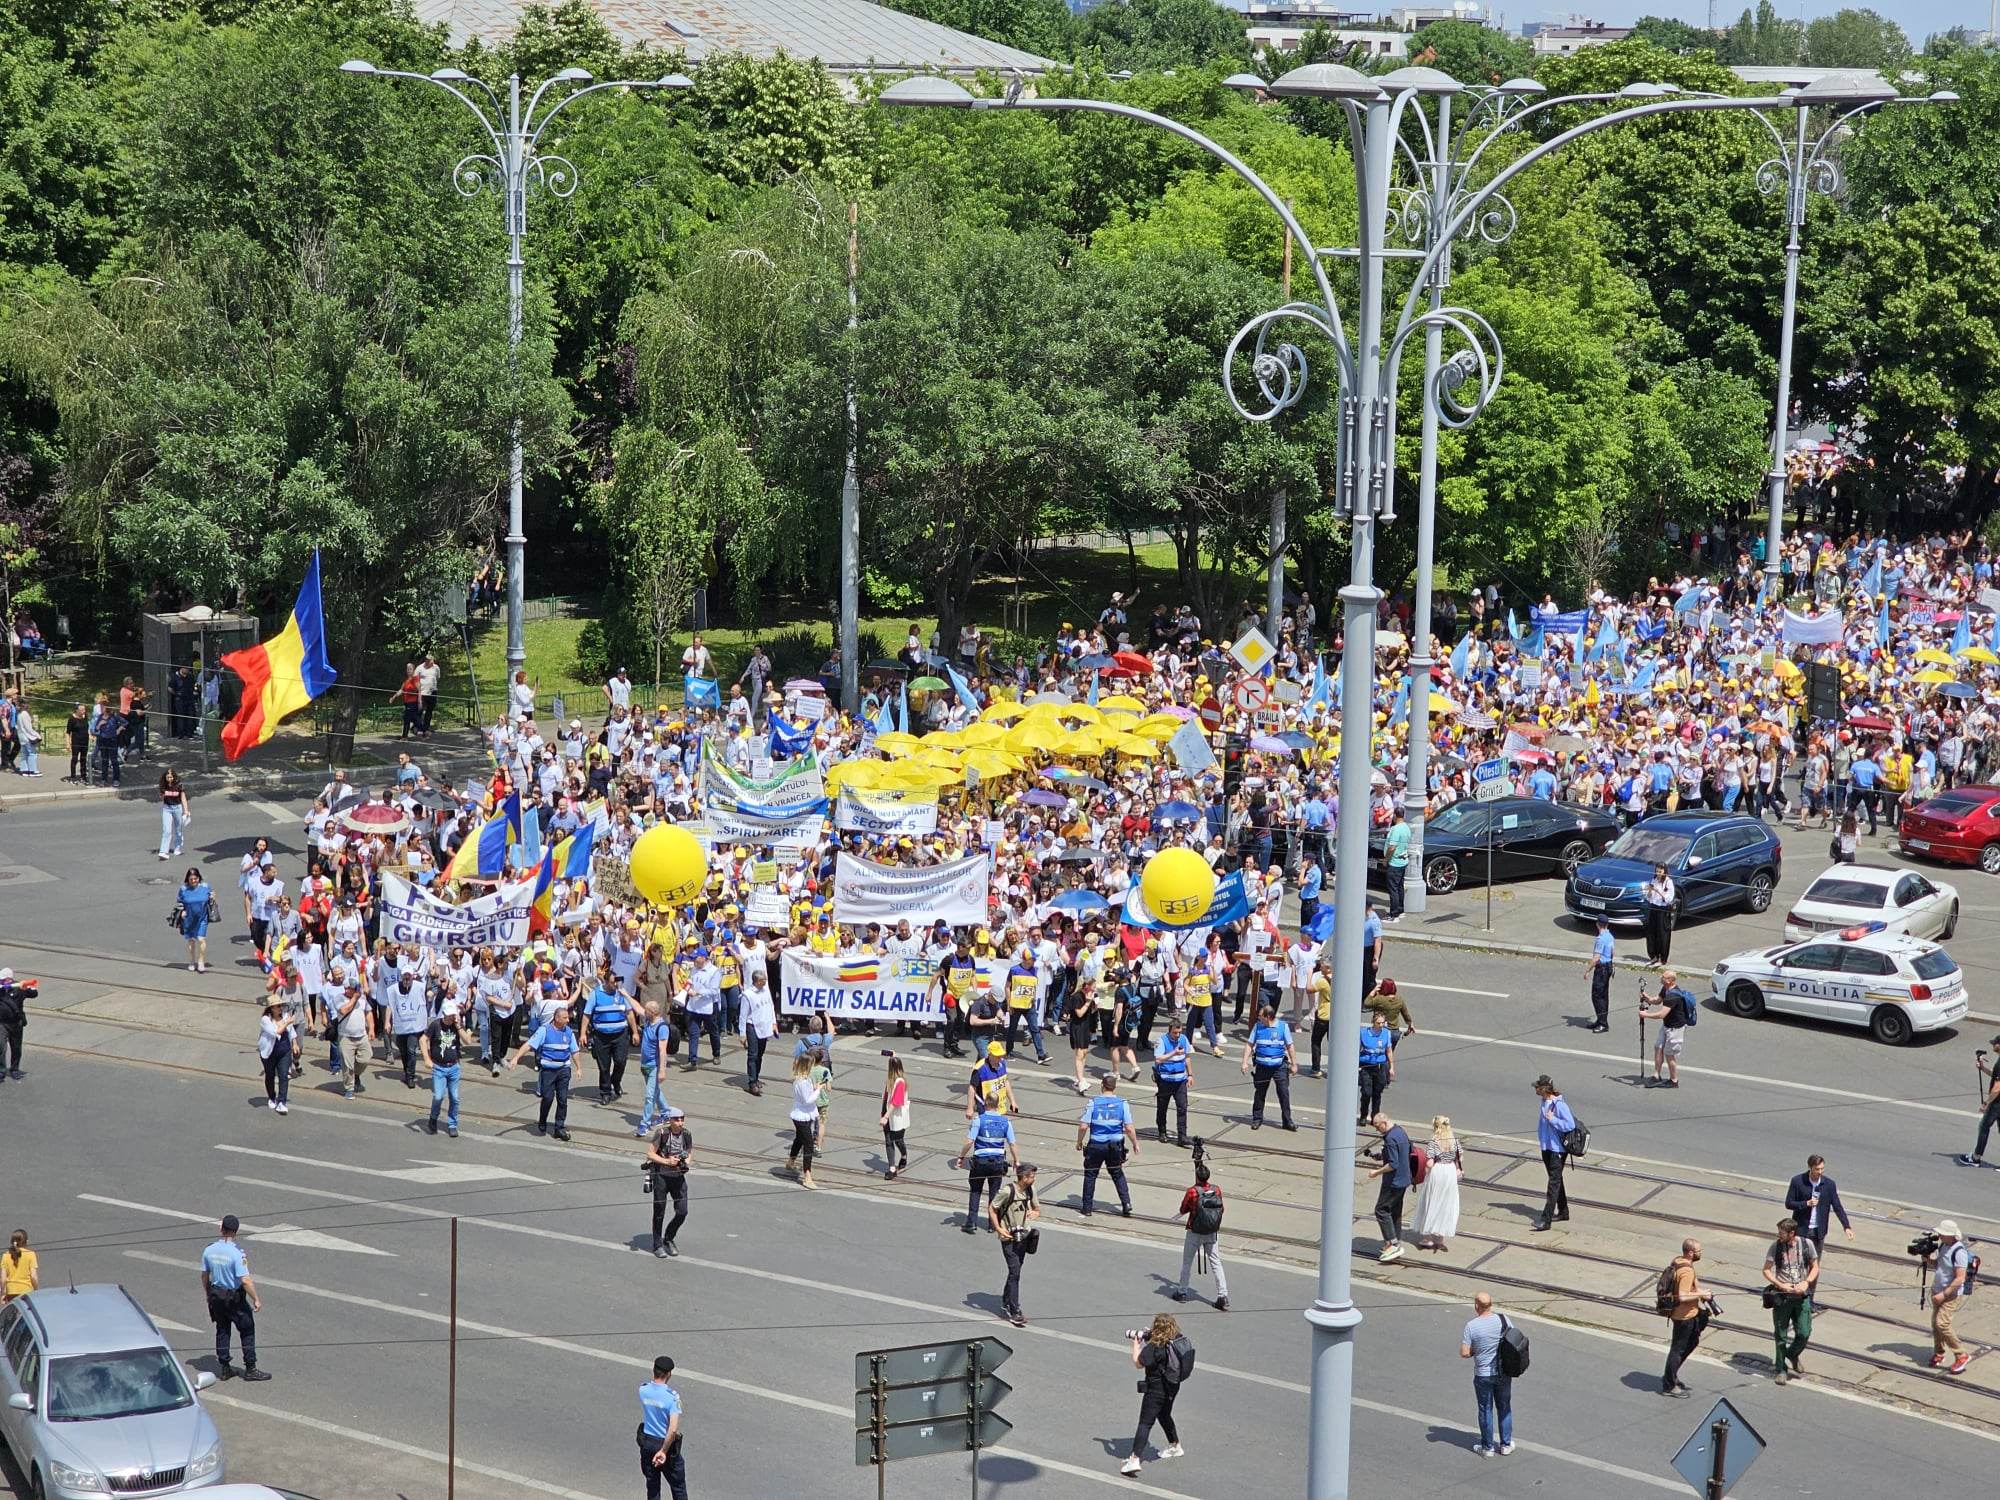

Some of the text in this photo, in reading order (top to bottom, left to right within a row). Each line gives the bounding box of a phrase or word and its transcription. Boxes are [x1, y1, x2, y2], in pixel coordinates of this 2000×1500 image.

[851, 815, 917, 831] SECTOR 5
[889, 902, 934, 912] SUCEAVA
[1160, 896, 1199, 914] FSE
[394, 922, 515, 946] GIURGIU
[787, 986, 845, 1009] VREM
